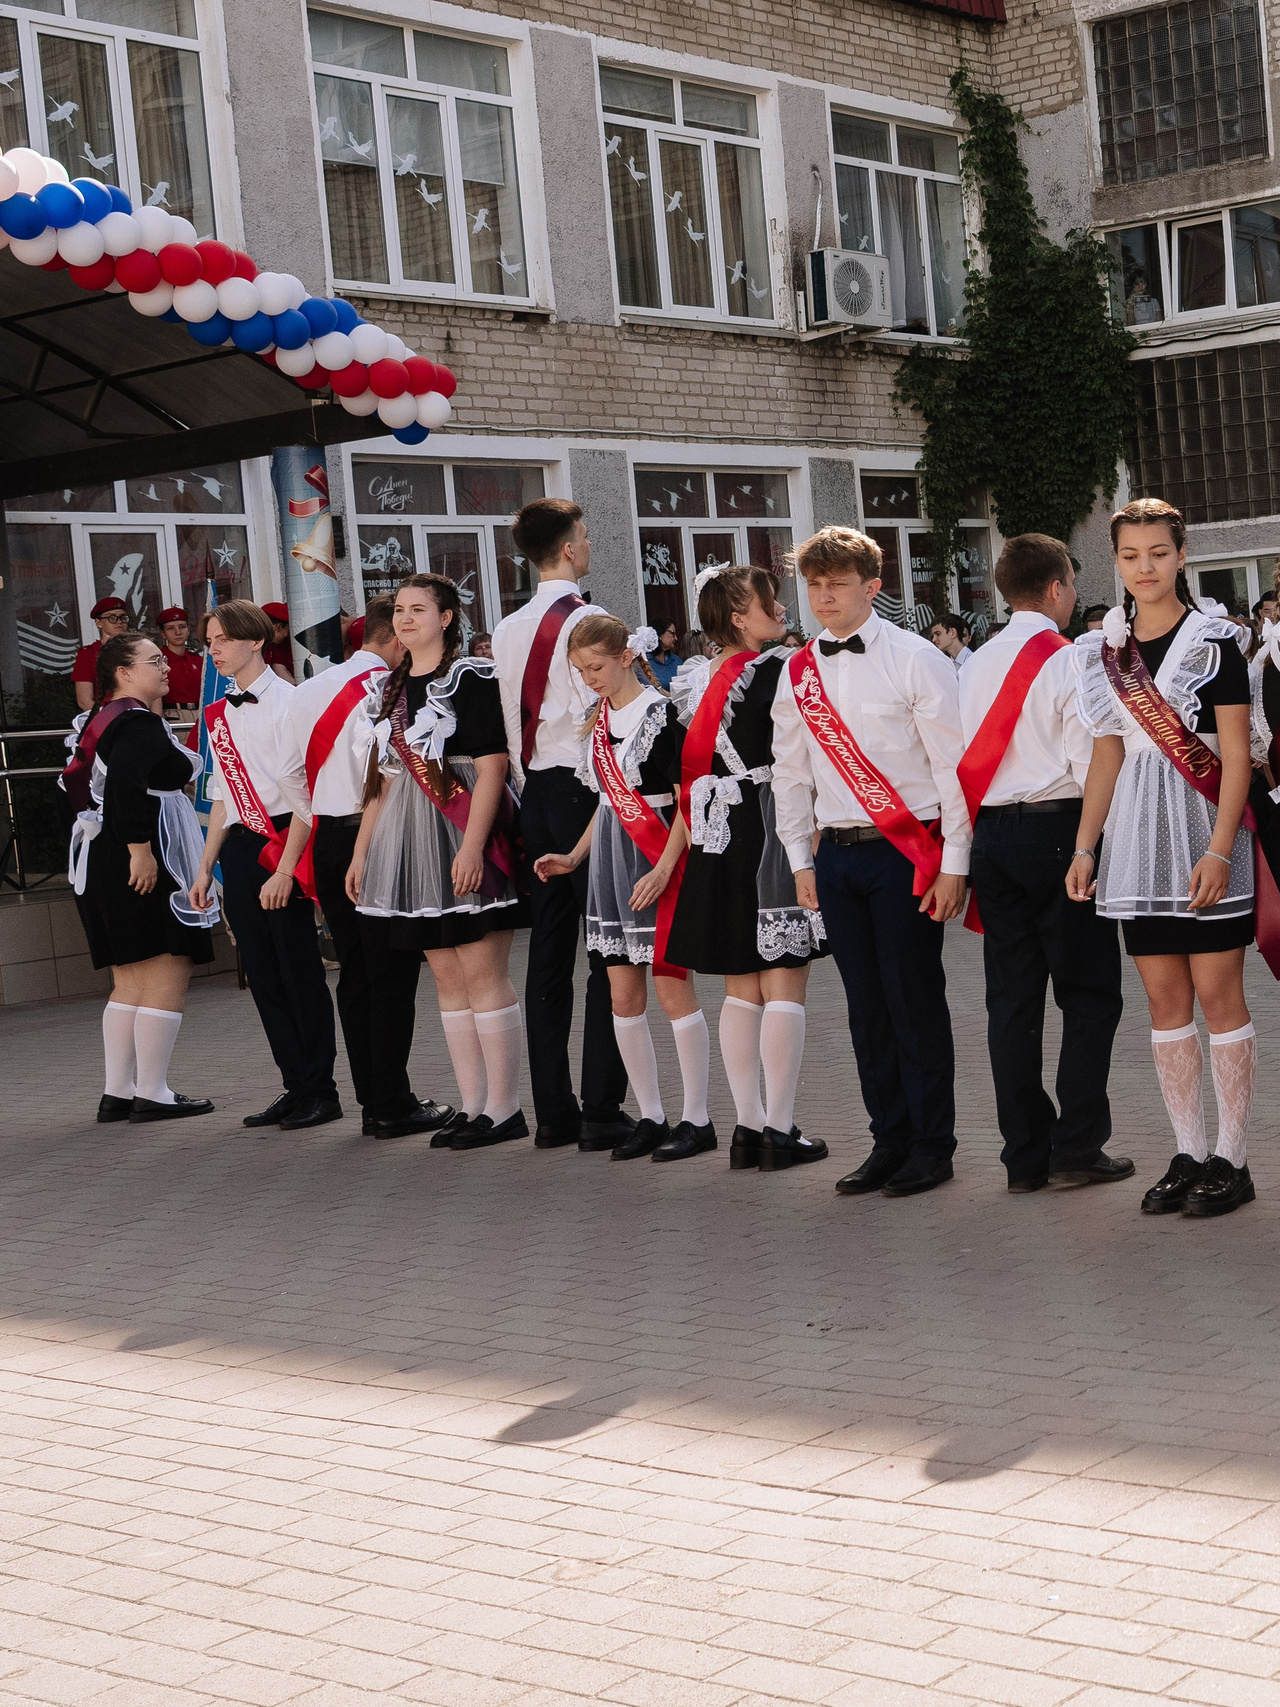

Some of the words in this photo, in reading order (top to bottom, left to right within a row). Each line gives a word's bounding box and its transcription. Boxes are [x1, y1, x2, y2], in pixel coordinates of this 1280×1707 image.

[363, 579, 392, 589] СПАСИБО
[216, 741, 253, 813] Выпускник
[244, 809, 269, 834] 2025
[594, 719, 625, 797] Выпускник
[618, 794, 647, 822] 2025
[801, 696, 871, 783] Выпускник
[857, 781, 896, 813] 2025
[1172, 737, 1220, 779] 2025
